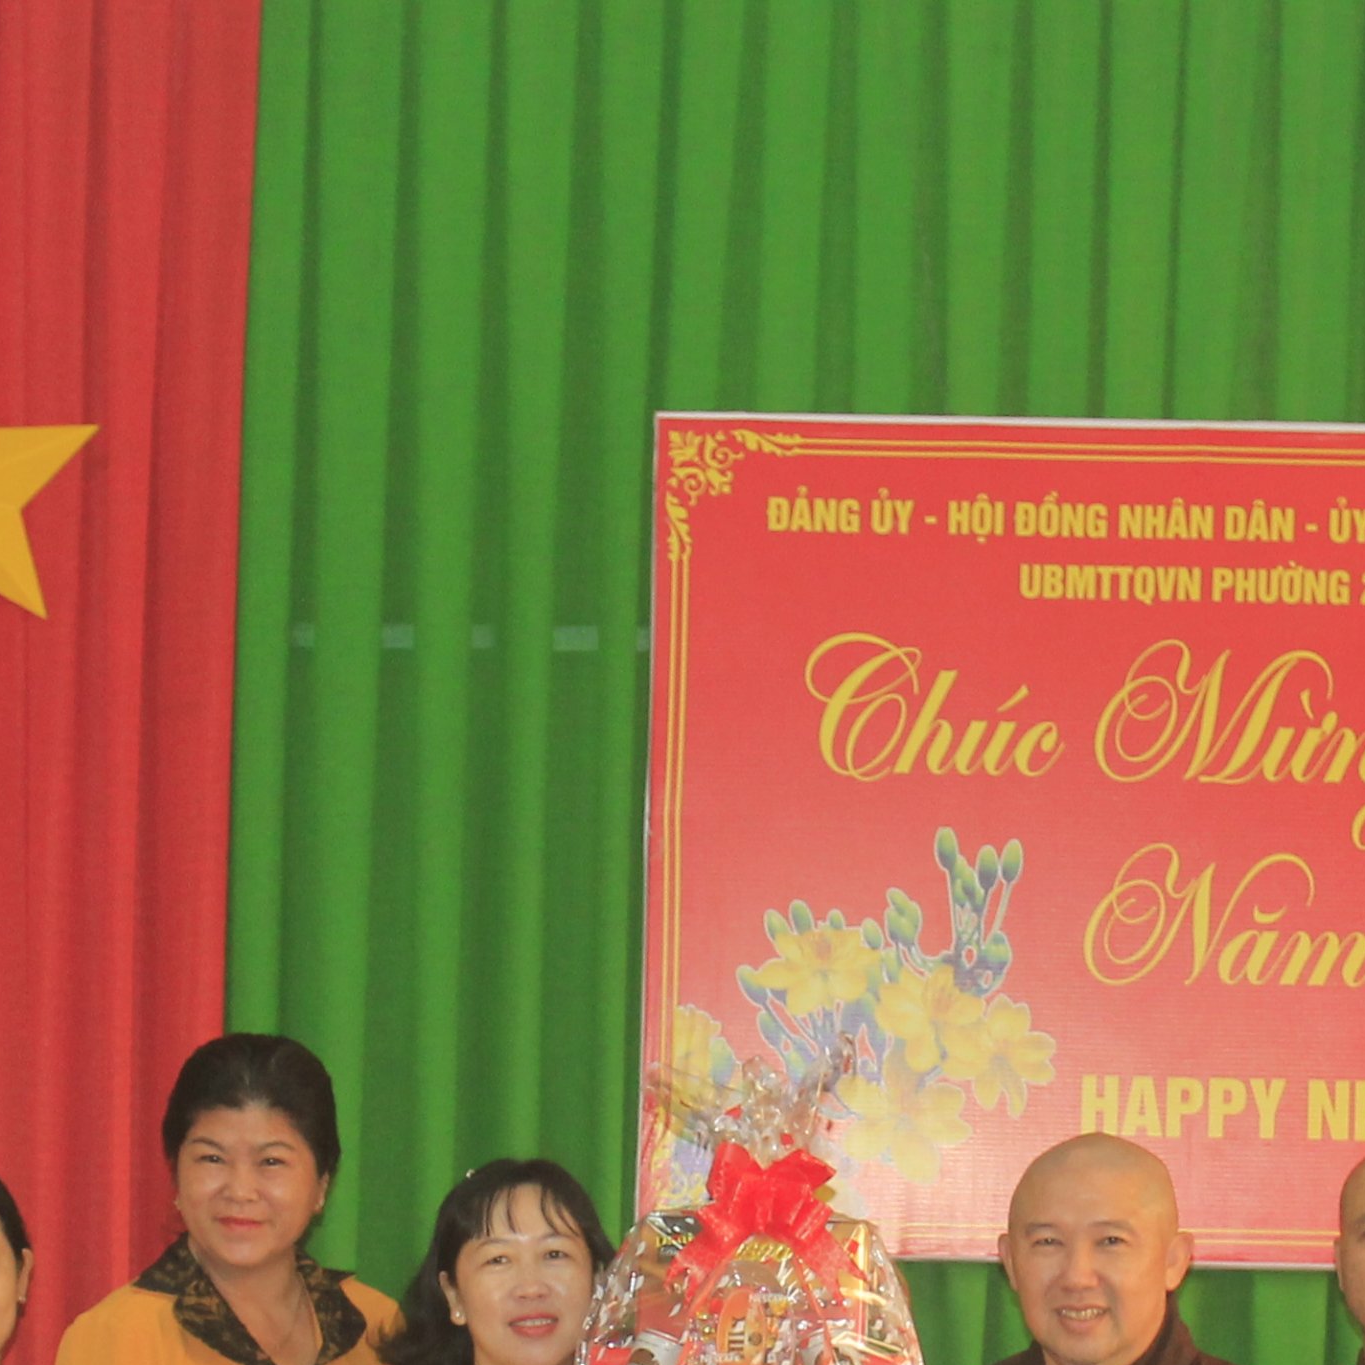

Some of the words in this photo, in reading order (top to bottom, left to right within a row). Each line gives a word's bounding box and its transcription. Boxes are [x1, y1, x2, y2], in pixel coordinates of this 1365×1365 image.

[767, 486, 861, 533] ĐẢNG
[869, 487, 914, 534] ỦY
[947, 493, 1005, 544] HỘI
[1014, 491, 1108, 539] ĐỒNG
[1118, 497, 1214, 541] NHÂN
[1223, 498, 1296, 542] DÂN
[1019, 563, 1202, 605] UBMTTQVN
[1210, 560, 1351, 606] PHƯỜNG
[804, 632, 1064, 781] Chúc
[1080, 1073, 1288, 1139] HAPPY
